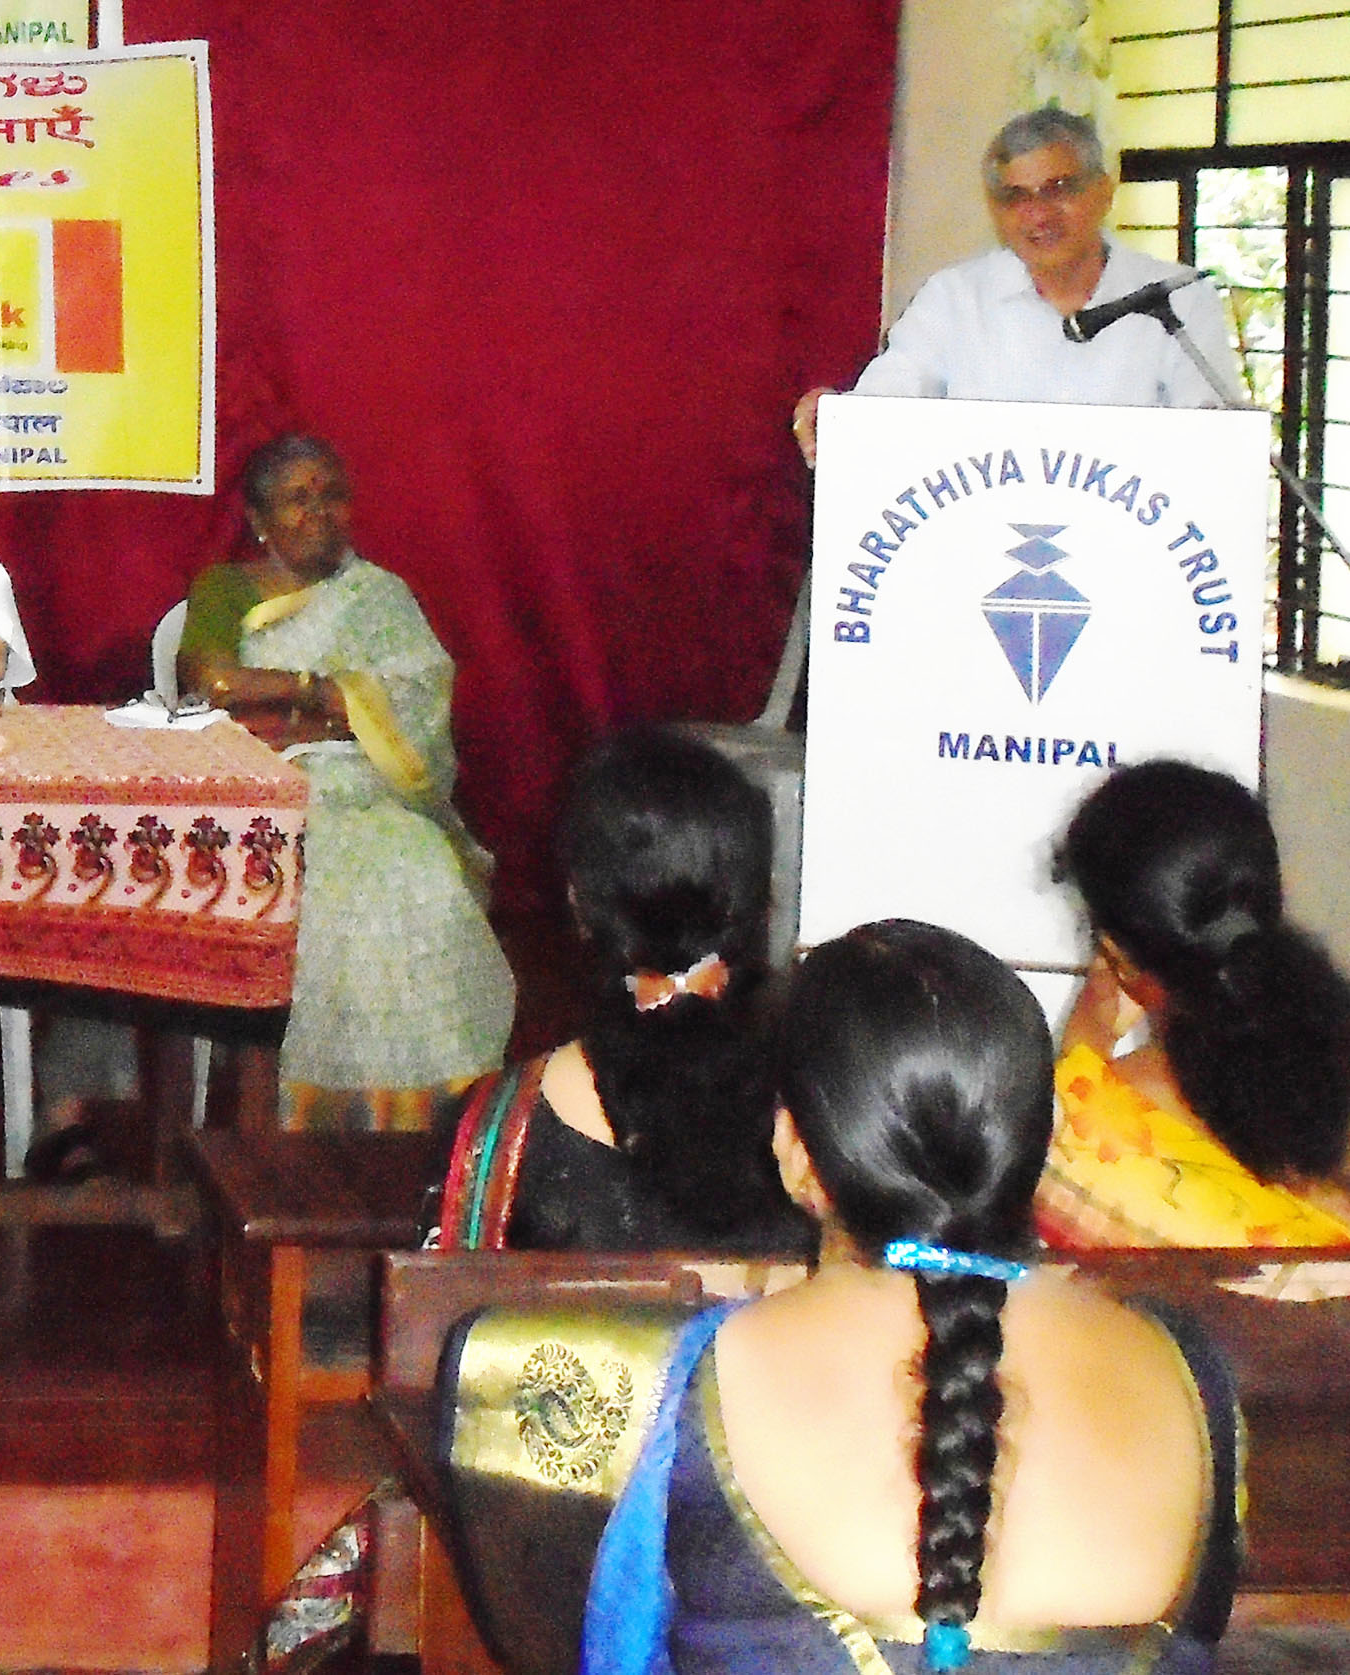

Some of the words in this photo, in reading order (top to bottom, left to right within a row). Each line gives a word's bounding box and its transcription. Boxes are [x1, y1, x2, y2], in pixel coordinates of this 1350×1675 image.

[834, 449, 1025, 643] BHARATHIYA
[1040, 448, 1170, 525] VIKAS
[1167, 521, 1238, 662] TRUST
[938, 731, 1121, 768] MANIPAL
